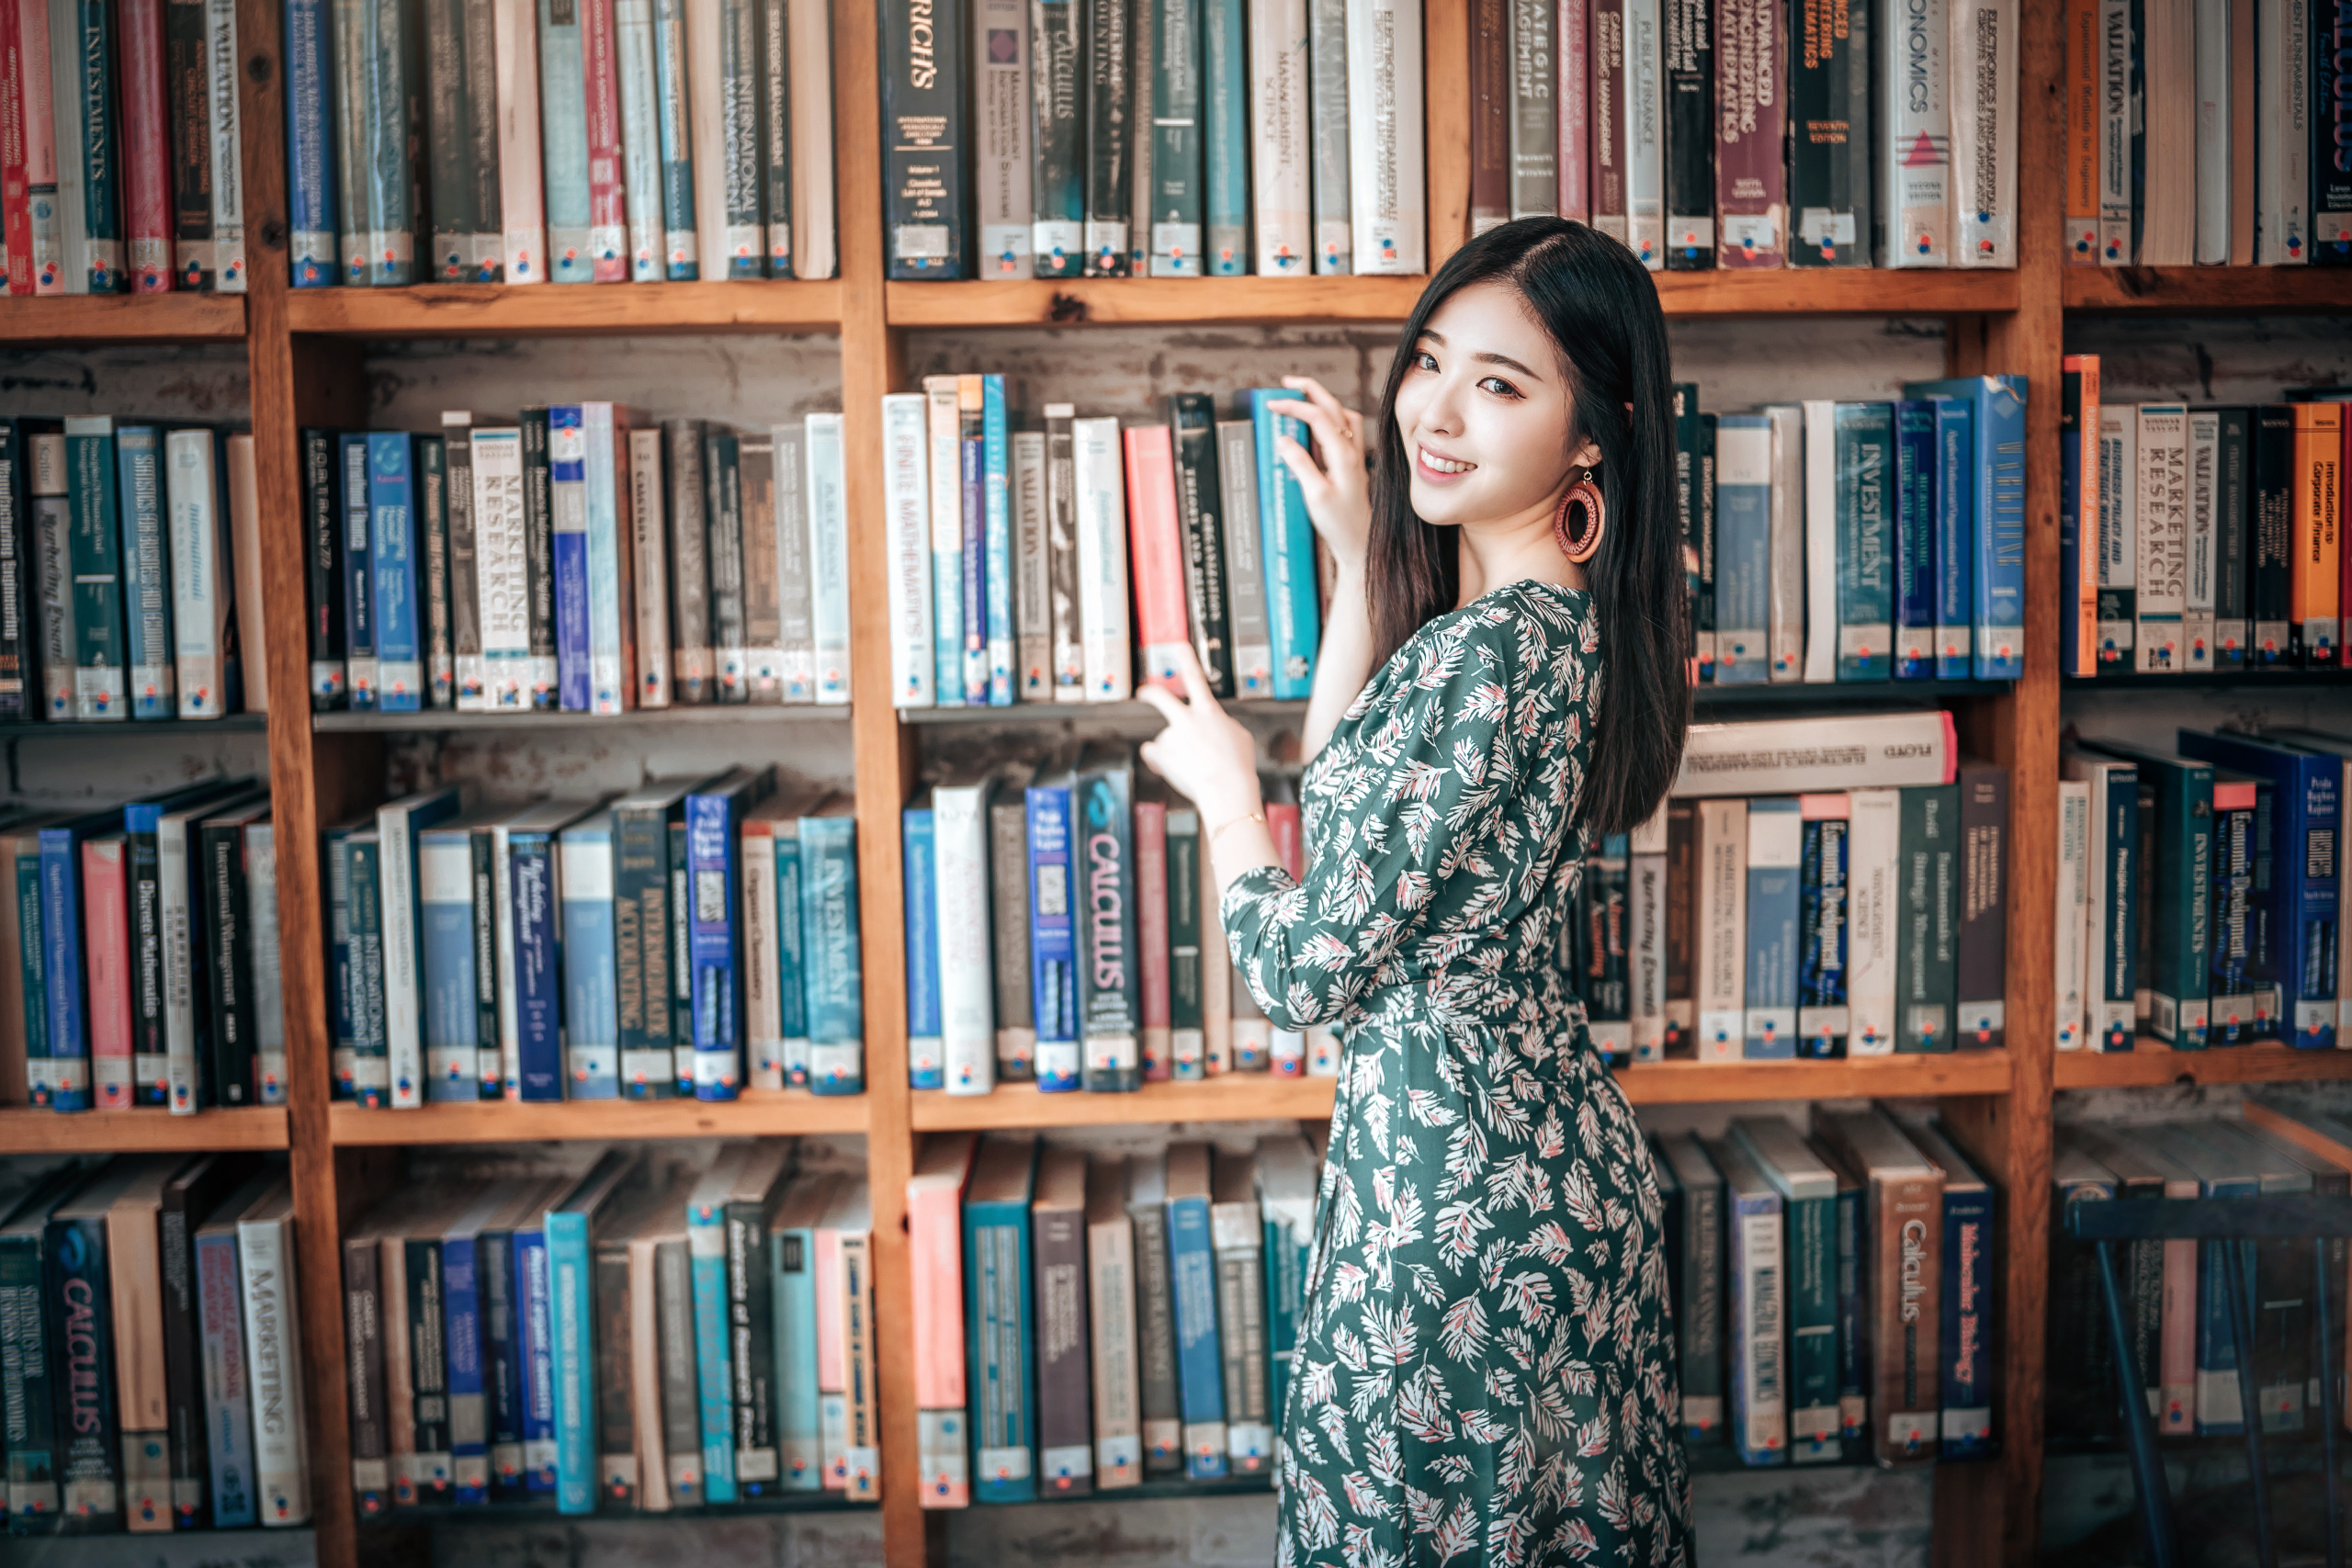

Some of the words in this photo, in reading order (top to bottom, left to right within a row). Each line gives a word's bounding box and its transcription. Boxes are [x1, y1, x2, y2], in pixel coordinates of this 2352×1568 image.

[770, 9, 782, 73] STRATEGIC
[1175, 23, 1186, 67] Financial
[1384, 10, 1396, 107] ELECTRONICS
[1599, 11, 1611, 78] STRATEGIC
[1610, 11, 1622, 51] CASES
[1611, 54, 1622, 67] IN
[1640, 20, 1654, 75] PUBLIC
[1695, 26, 1710, 50] and
[1739, 0, 1757, 134] ENGINEERING
[1756, 0, 1773, 107] ADVANCED
[1908, 0, 1928, 114] ONOMICS
[1985, 8, 1998, 105] ELECTRONICS
[2079, 10, 2093, 82] Experimental
[2107, 9, 2124, 116] VALUATION
[86, 26, 107, 182] INVESTMENTS
[216, 22, 236, 134] VALUATION
[1054, 30, 1075, 120] CALCULUS
[1176, 68, 1187, 92] And
[1265, 76, 1278, 144] SCIENCE
[1276, 51, 1292, 167] MANAGEMENT
[1722, 0, 1740, 144] MATHEMATICS
[2080, 84, 2094, 135] Methods
[2292, 32, 2304, 131] FUNDAMENTALS
[2320, 71, 2333, 117] Edition
[724, 76, 740, 213] MANAGEMENT
[738, 75, 756, 212] INTERNATIONAL
[772, 76, 785, 167] MANAGEMENT
[999, 70, 1011, 157] INFORMATION
[1011, 69, 1022, 163] MANAGEMENT
[1600, 79, 1612, 167] MANAGEMENT
[1642, 79, 1655, 147] FINANCE
[1805, 119, 1849, 132] SEVENTH
[1808, 132, 1849, 143] EDITION
[1976, 116, 1987, 144] AND
[2081, 136, 2093, 152] for
[1001, 162, 1012, 220] SYSTEMS
[1985, 107, 1998, 218] FUNDAMENTALS
[134, 454, 157, 512] STATISTICS
[895, 434, 918, 493] FINITE
[1945, 428, 1958, 461] Applied
[2085, 405, 2097, 491] FUNDAMENTALS
[2098, 438, 2110, 500] STRATEGIC
[2111, 438, 2122, 496] BUSINESS
[0, 459, 14, 558] Manufacturing
[137, 513, 159, 535] FOR
[315, 438, 330, 547] FORTRAN
[1022, 467, 1039, 556] VALUATION
[1183, 468, 1200, 525] THEORY
[1860, 442, 1882, 591] INVESTMENT
[2085, 491, 2096, 506] OF
[2112, 498, 2122, 532] POLICY
[2148, 447, 2166, 597] RESEARCH
[2166, 446, 2185, 598] MARKETING
[2194, 445, 2211, 534] VALUATION
[2309, 460, 2323, 517] Corporate
[2324, 460, 2335, 524] Introduction
[138, 536, 162, 586] BUSINESS
[484, 476, 509, 632] RESEARCH
[504, 475, 528, 634] MARKETING
[899, 498, 924, 638] MATHEMATICS
[1189, 532, 1203, 563] AND
[1201, 513, 1222, 623] ORGANIZATION
[2085, 509, 2096, 586] MANAGEMENT
[2099, 503, 2110, 586] MANAGEMENT
[2112, 536, 2122, 566] AND
[2312, 520, 2324, 564] Finance
[2324, 529, 2335, 546] to
[2, 558, 18, 641] Engineering
[141, 587, 164, 612] AND
[1945, 569, 1959, 618] Psychology
[1883, 742, 1932, 761] FLOYD
[215, 841, 236, 919] International
[1820, 821, 1846, 887] Economic
[1908, 852, 1928, 911] Strategic
[2114, 848, 2129, 893] Principles
[2231, 812, 2251, 877] Economic
[139, 879, 156, 934] Discrete
[517, 863, 534, 944] Management
[530, 857, 547, 924] Marketing
[748, 867, 762, 924] Organic
[1088, 832, 1125, 990] CALCULUS
[1608, 887, 1625, 957] Advanced
[1640, 868, 1658, 951] Marketing
[1815, 886, 1847, 972] Development
[1937, 851, 1951, 942] Fundamentals
[2115, 894, 2128, 907] of
[2191, 834, 2208, 955] INVESTMENTS
[2227, 876, 2252, 960] Development
[141, 934, 160, 1019] Mathematics
[218, 924, 236, 1007] Management
[616, 895, 642, 1030] ACCOUNTING
[642, 887, 668, 1039] INTERMEDIATE
[750, 926, 765, 1001] Chemistry
[1588, 900, 1607, 978] Accounting
[1910, 912, 1928, 999] Management
[1938, 943, 1951, 962] of
[349, 934, 367, 1047] MANAGEMENT
[364, 932, 385, 1047] INTERNATIONAL
[1752, 1266, 1778, 1339] MANAGERIAL
[1900, 1218, 1927, 1323] Calculus
[1959, 1222, 1980, 1313] Molecular
[20, 1285, 43, 1345] STATISTICS
[248, 1268, 286, 1435] MARKETING
[732, 1303, 748, 1325] of
[1954, 1313, 1980, 1385] Biology
[62, 1277, 102, 1435] CALCULUS
[698, 1268, 724, 1439] economics
[733, 1325, 752, 1404] Research
[1754, 1341, 1780, 1404] ECONOMICS
